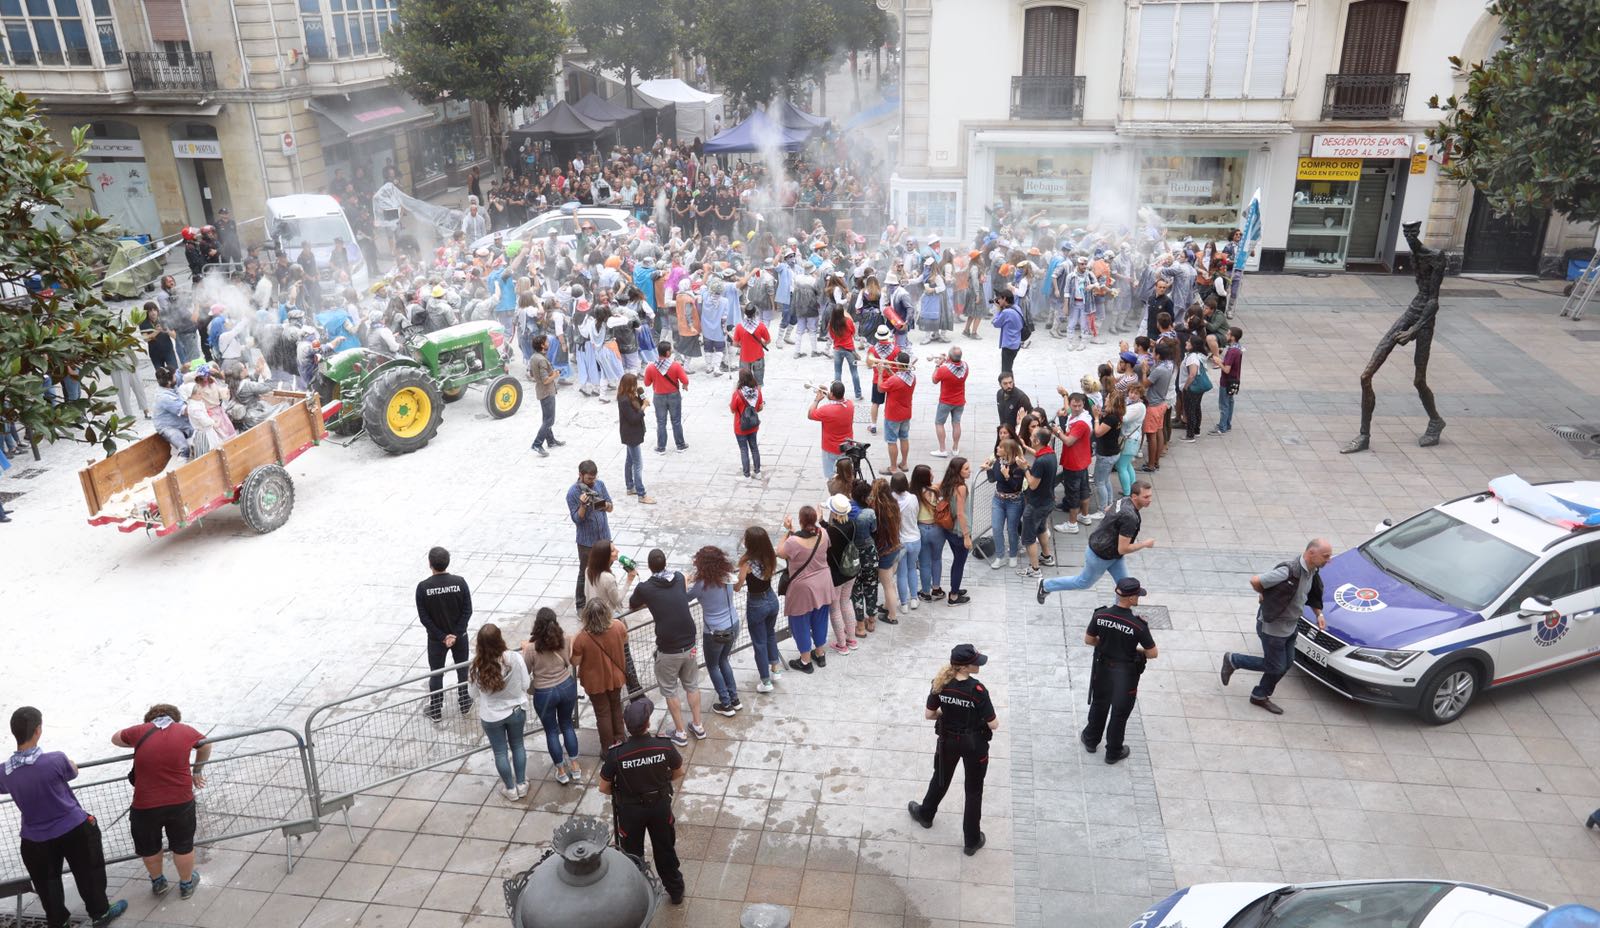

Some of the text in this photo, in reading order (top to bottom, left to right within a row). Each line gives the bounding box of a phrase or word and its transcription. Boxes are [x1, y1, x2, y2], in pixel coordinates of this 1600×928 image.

[1321, 137, 1407, 147] DESCUENTOS EN OR
[1333, 148, 1359, 156] TODO
[1361, 148, 1373, 156] AL
[1300, 161, 1360, 169] COMPRO ORO
[1025, 180, 1065, 193] Rebajas
[1169, 182, 1210, 195] Rebajas
[426, 585, 461, 596] ERTZAINTZA
[1096, 618, 1134, 635] ERTZAINTZA
[1305, 646, 1326, 666] 2384
[622, 753, 666, 769] ERTZAINTZA
